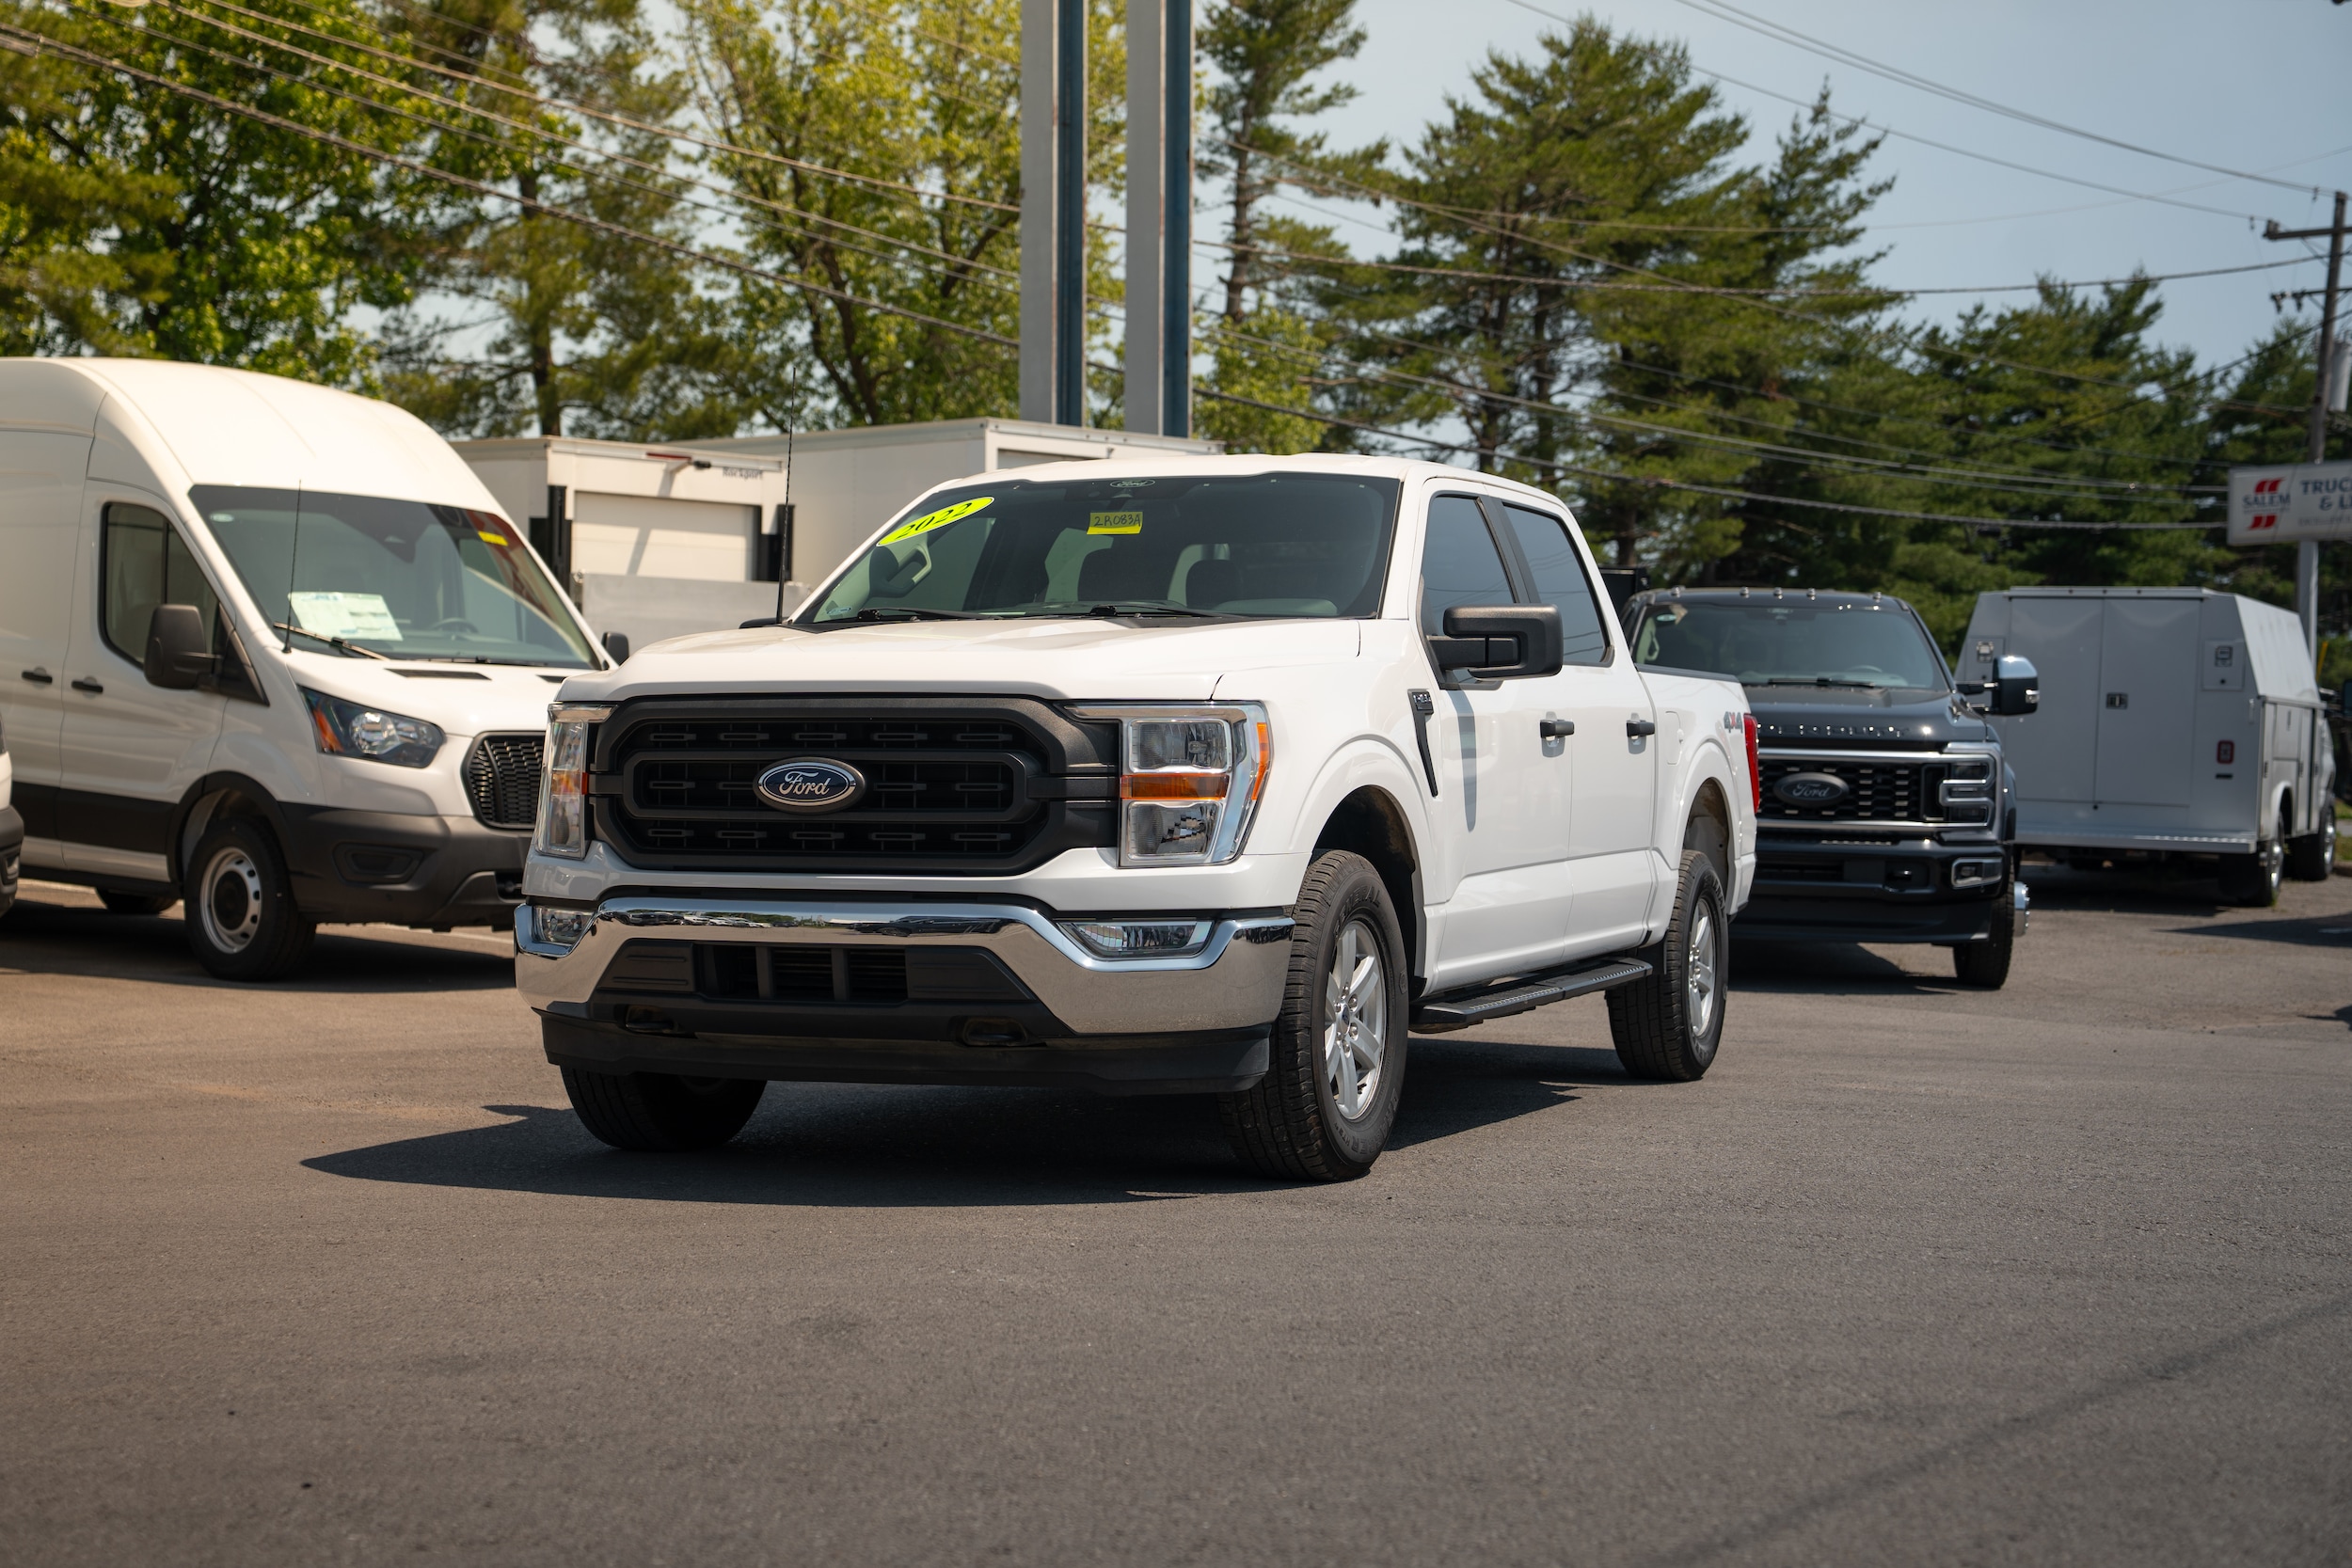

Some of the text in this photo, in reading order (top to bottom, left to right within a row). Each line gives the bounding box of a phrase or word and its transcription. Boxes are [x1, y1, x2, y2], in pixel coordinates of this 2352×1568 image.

[2300, 477, 2352, 495] TRUC
[2242, 493, 2291, 506] SALEM
[894, 502, 973, 541] 2022
[779, 771, 831, 795] Ford
[1792, 783, 1831, 798] Ford
